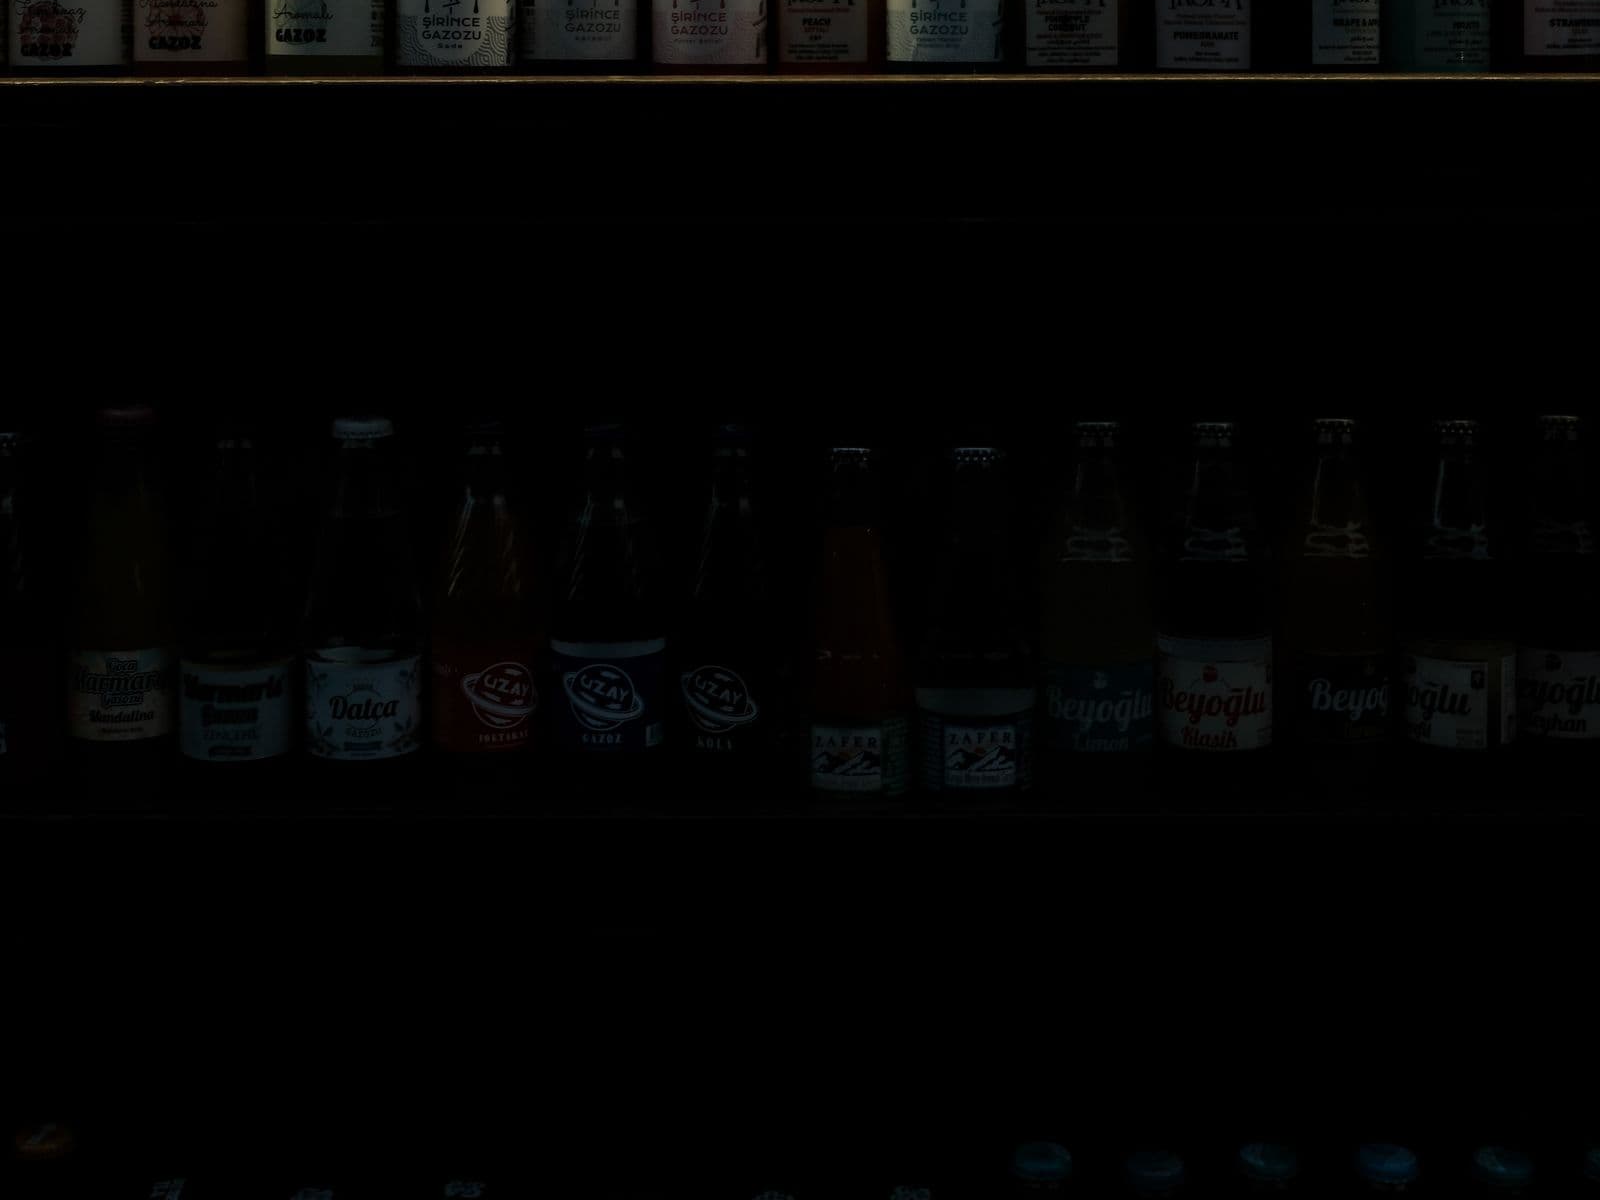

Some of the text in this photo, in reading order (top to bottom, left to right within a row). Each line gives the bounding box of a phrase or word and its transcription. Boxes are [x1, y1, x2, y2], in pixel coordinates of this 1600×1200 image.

[565, 7, 620, 21] ŞİRİNCE
[671, 11, 727, 24] ŞİRİNCE
[909, 11, 968, 24] ŞİRİNCE
[422, 16, 481, 30] ŞİRİNCE
[564, 22, 621, 34] GAZOZU
[802, 18, 831, 26] PEACH
[276, 29, 328, 43] GAZOZ
[422, 29, 482, 41] GAZOZU
[670, 25, 728, 37] GAZOZU
[909, 25, 969, 36] GAZOZU
[149, 36, 202, 50] GAZOZ
[580, 674, 630, 702] UZAY
[694, 675, 744, 705] UZAY
[1163, 685, 1269, 727] Beyoğlu
[815, 735, 879, 748] ZAFER
[950, 731, 1012, 746] ZAFER
